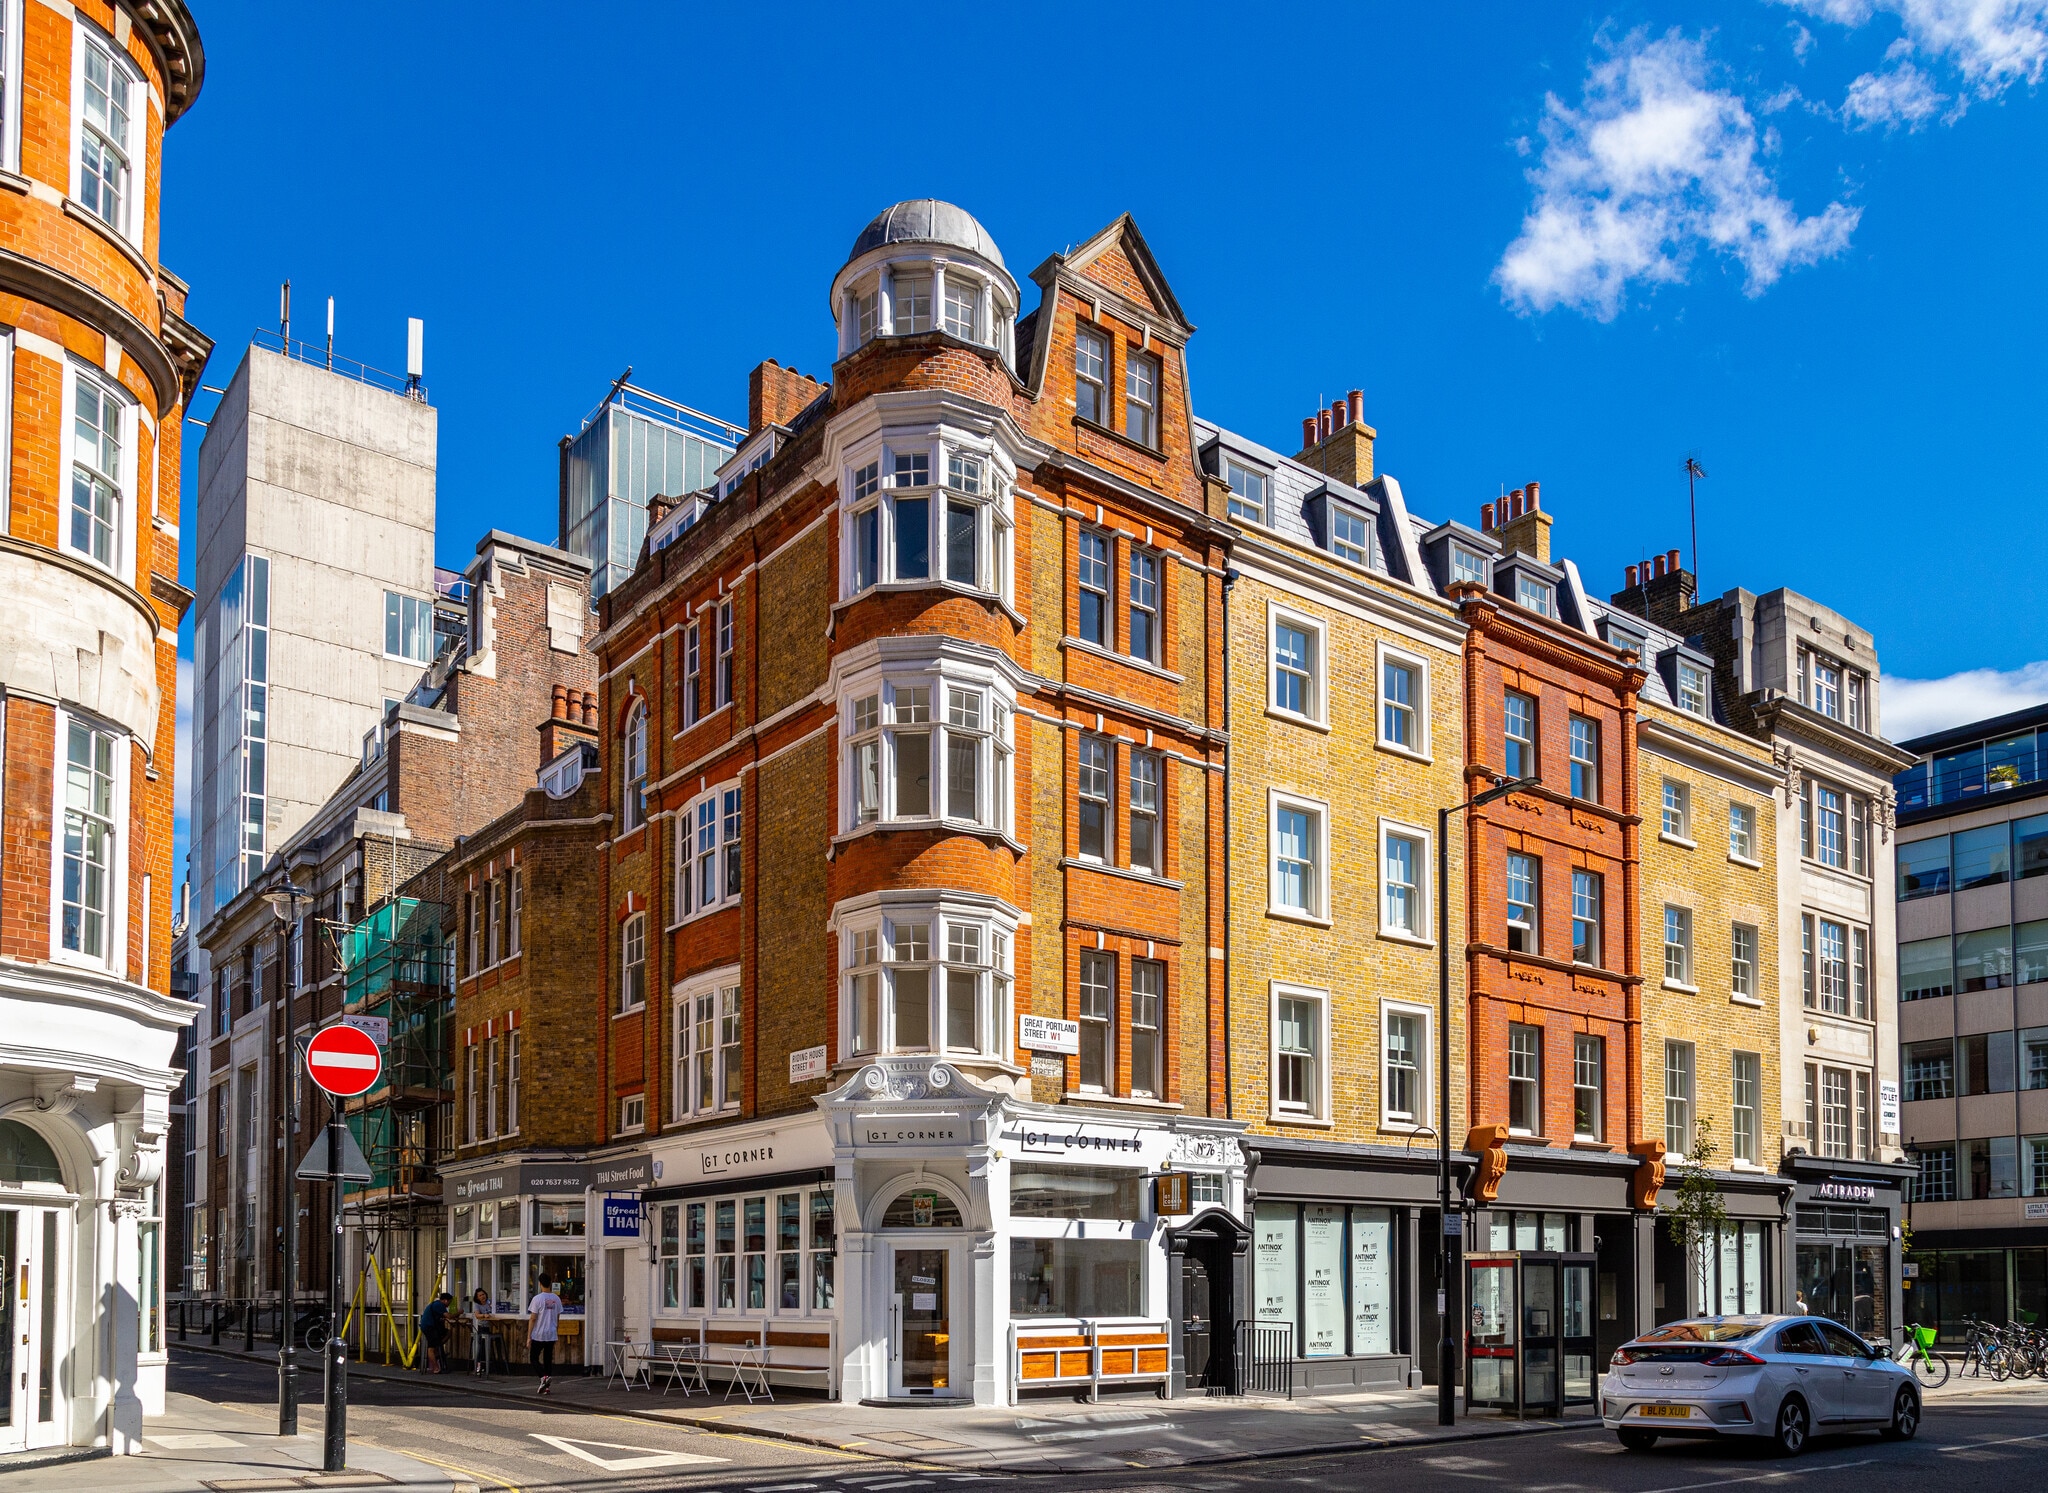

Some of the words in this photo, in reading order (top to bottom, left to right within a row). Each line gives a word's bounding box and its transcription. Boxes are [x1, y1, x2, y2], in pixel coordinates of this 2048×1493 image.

[1024, 1018, 1043, 1028] GREAT
[1046, 1021, 1077, 1033] PORTLAND
[1024, 1028, 1047, 1039] STREET
[1050, 1032, 1061, 1041] W1
[792, 1052, 808, 1064] RIDING
[809, 1048, 824, 1059] HOUSE
[792, 1062, 808, 1073] STREET
[809, 1060, 815, 1069] W1
[1880, 1093, 1888, 1101] TO
[1888, 1094, 1898, 1102] LET
[871, 1132, 887, 1140] GT
[897, 1131, 954, 1139] CORNER
[1026, 1132, 1050, 1147] GT
[1064, 1134, 1141, 1153] CORNER
[704, 1155, 718, 1168] GT
[725, 1147, 774, 1165] CORNER
[596, 1172, 610, 1184] THAI
[610, 1170, 628, 1183] Street
[628, 1166, 644, 1180] Food
[456, 1184, 466, 1196] the
[467, 1179, 489, 1198] Great
[489, 1176, 503, 1190] THAI
[545, 1178, 562, 1186] 7637
[563, 1178, 580, 1186] 8872
[612, 1206, 639, 1216] Great
[607, 1216, 639, 1229] THAI
[337, 1225, 343, 1234] 9
[1257, 1243, 1283, 1251] ANTINOX
[912, 1276, 935, 1284] CLOSED
[1647, 1406, 1667, 1416] BL19
[1668, 1406, 1688, 1416] XUU
